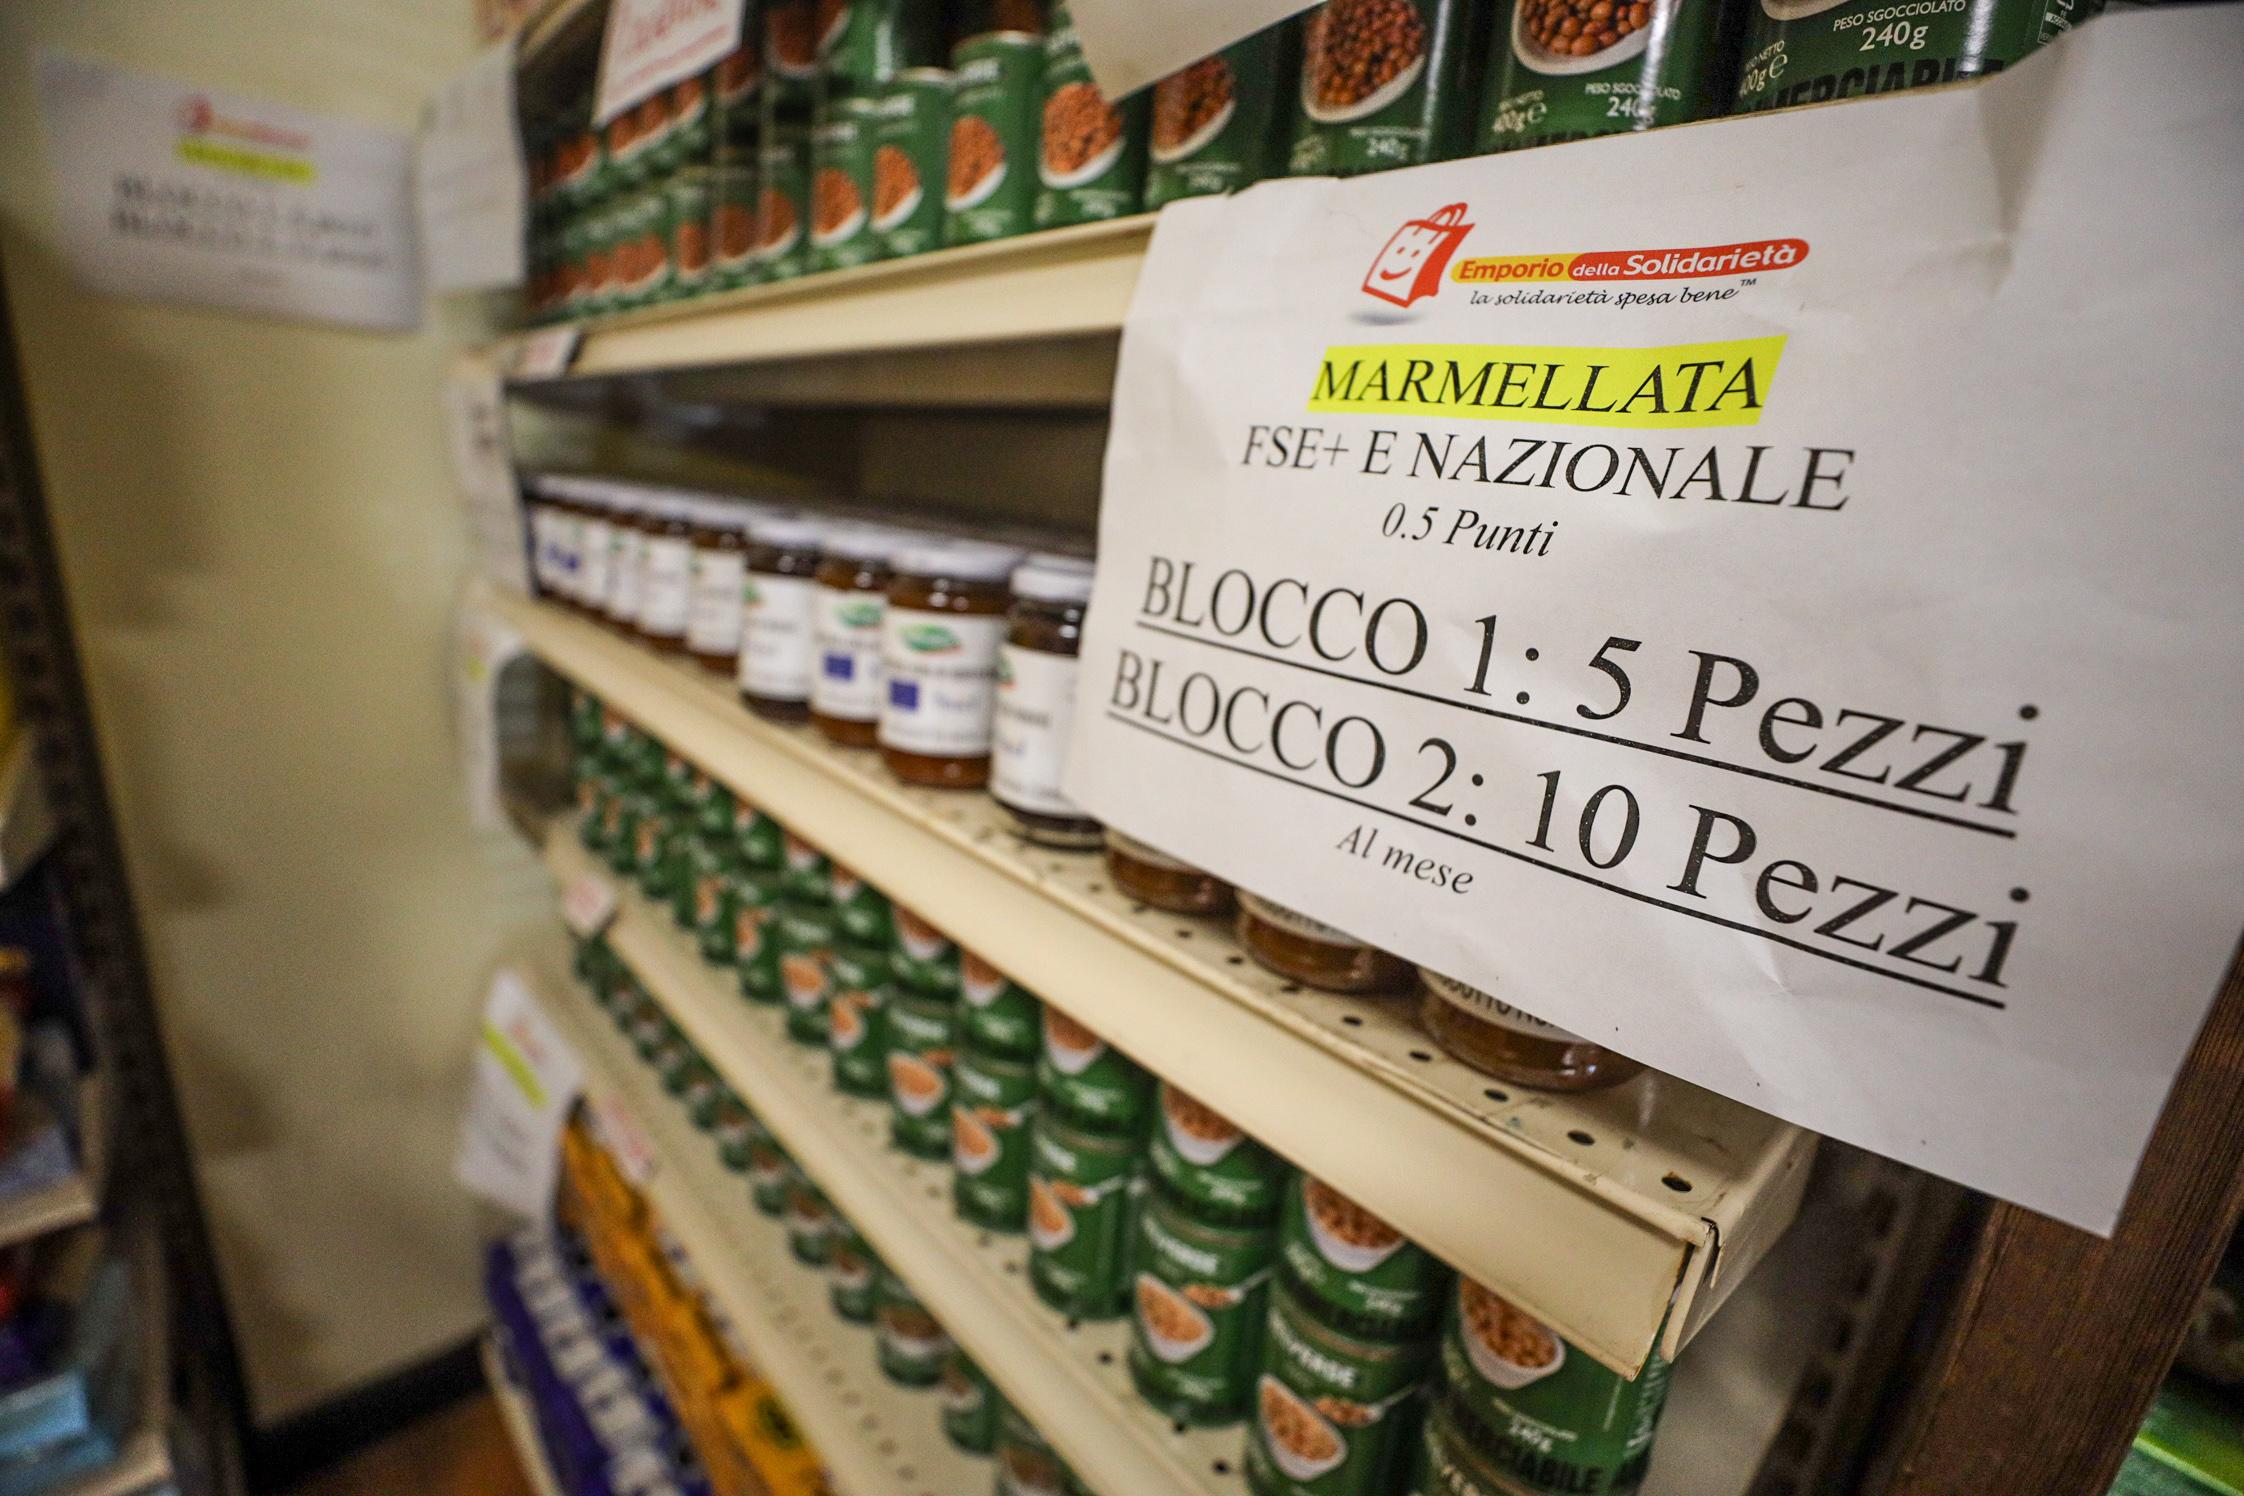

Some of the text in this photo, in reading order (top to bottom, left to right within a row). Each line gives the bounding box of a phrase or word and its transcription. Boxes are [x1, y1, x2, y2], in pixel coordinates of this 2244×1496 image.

[1833, 0, 1967, 31] PESO SGOCCIOLATO
[1859, 20, 1929, 51] 240g
[1459, 244, 1797, 282] Emporio della Solidarietà
[1470, 291, 1490, 305] la
[1494, 289, 1614, 306] solidarietà
[1614, 291, 1677, 309] spesa
[1312, 356, 1763, 414] MARMELLATA
[1242, 424, 1856, 512] FSE+ E NAZIONALE
[1381, 502, 1559, 558] 0.5 Punti
[1141, 556, 2040, 816] BLOCCO 1: 5 Pezzi
[1111, 650, 2031, 989] BLOCCO 2: 10 Pezzi
[1335, 825, 1474, 895] Al mese
